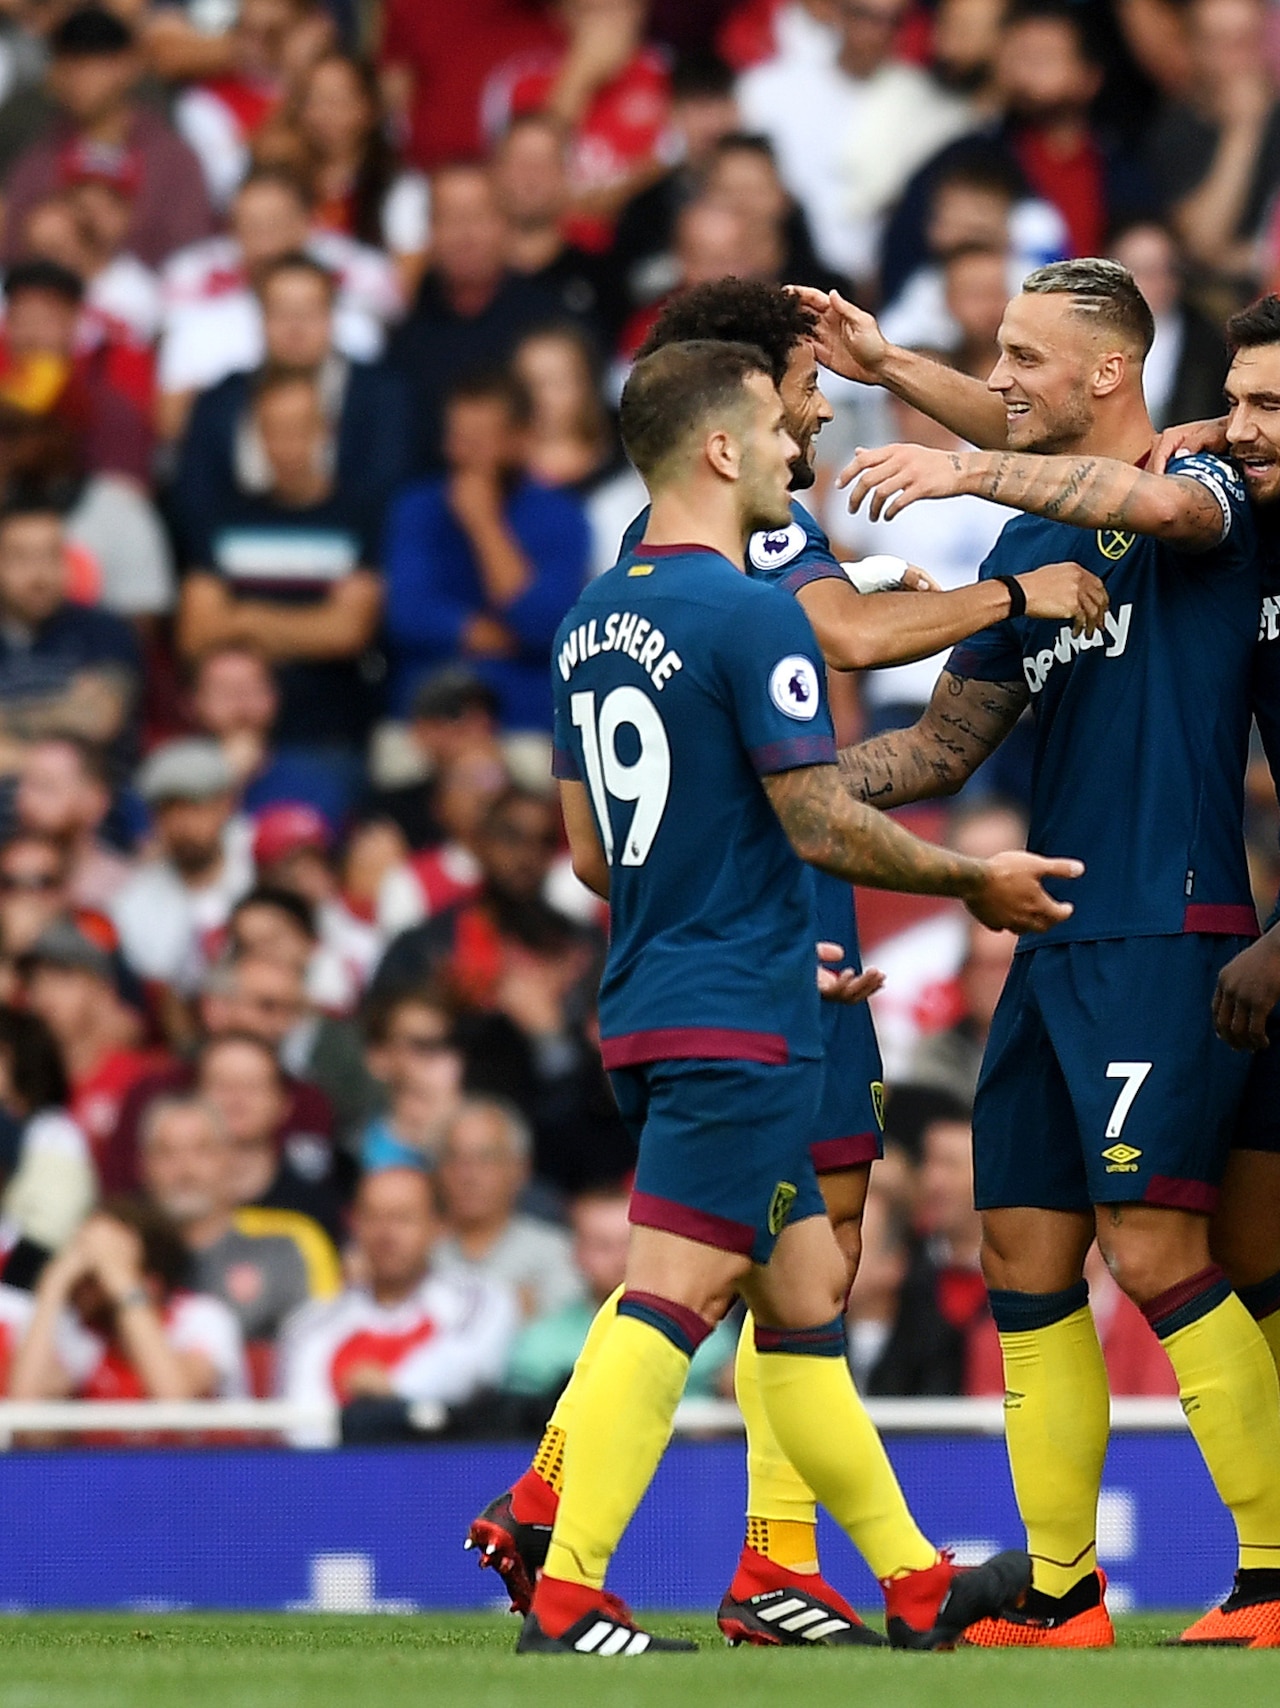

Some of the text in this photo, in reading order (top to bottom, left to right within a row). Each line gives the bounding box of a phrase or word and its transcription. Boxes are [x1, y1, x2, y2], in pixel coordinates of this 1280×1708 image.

[558, 612, 683, 691] WILSHERE
[570, 685, 671, 867] 19
[1104, 1061, 1153, 1138] 7
